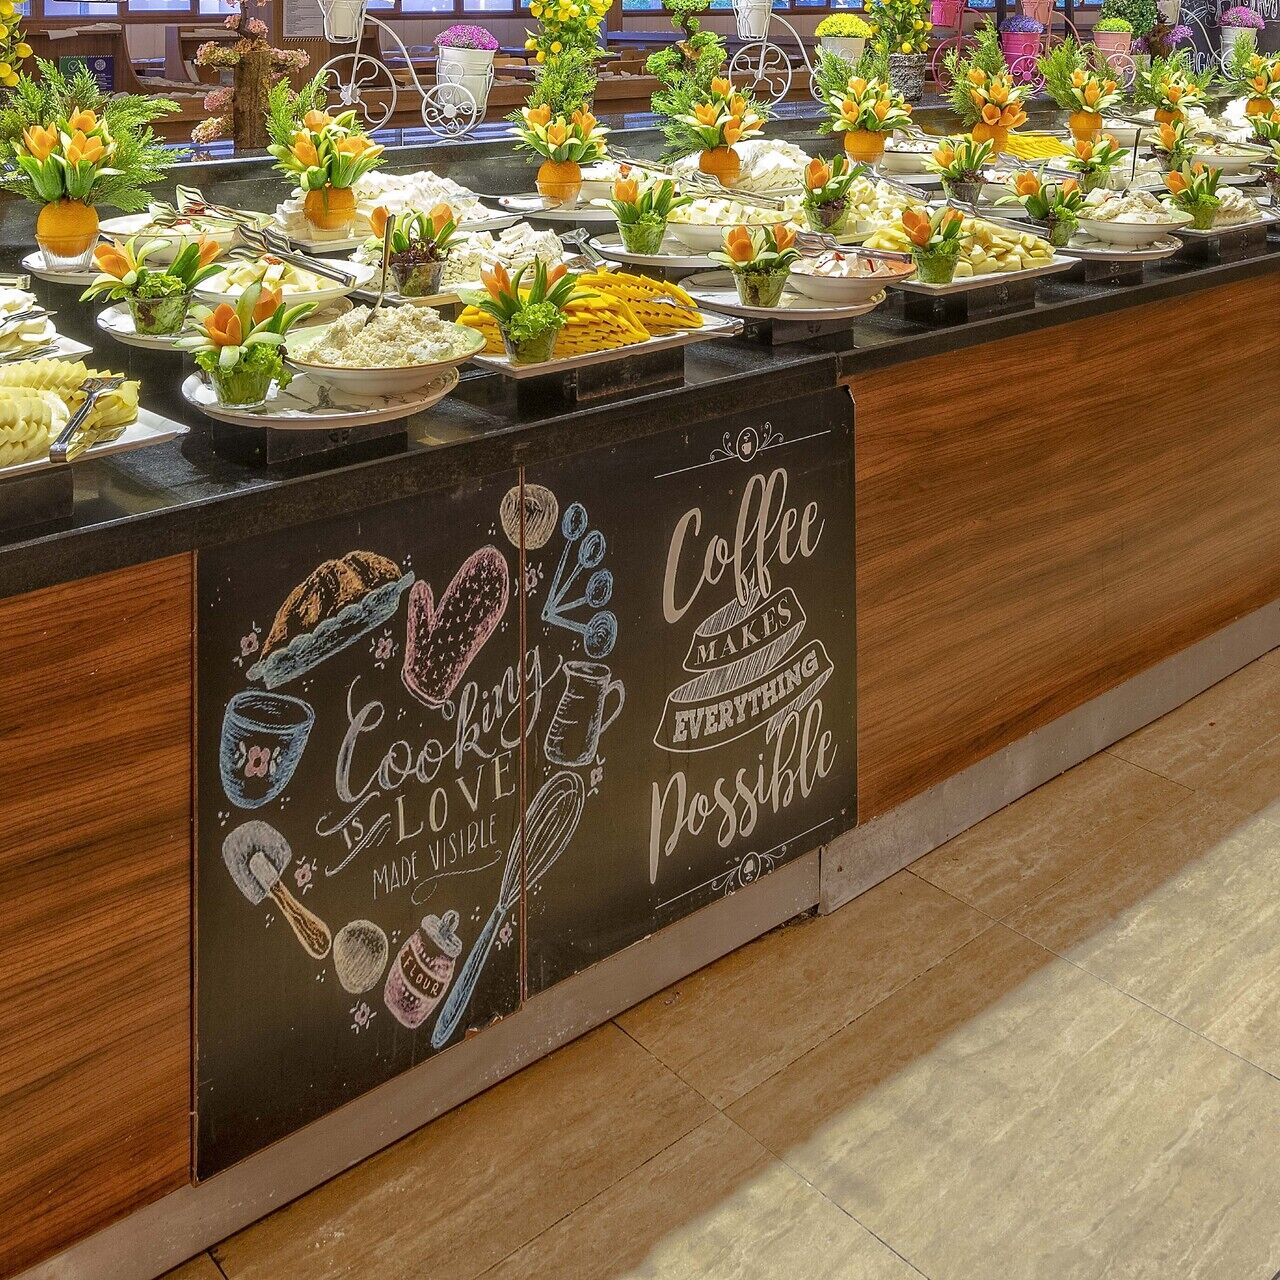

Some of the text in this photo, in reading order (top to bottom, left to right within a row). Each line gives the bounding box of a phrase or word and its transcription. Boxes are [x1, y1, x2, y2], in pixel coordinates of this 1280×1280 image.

[662, 467, 826, 625] Coffee
[693, 595, 794, 667] MAKES
[335, 646, 563, 804] Cooking
[672, 647, 821, 745] EVERYTHING
[342, 749, 517, 851] IS LOVE
[649, 699, 839, 886] Possible
[372, 813, 498, 901] MADE VISIBLE
[401, 954, 444, 1000] FLOUR
